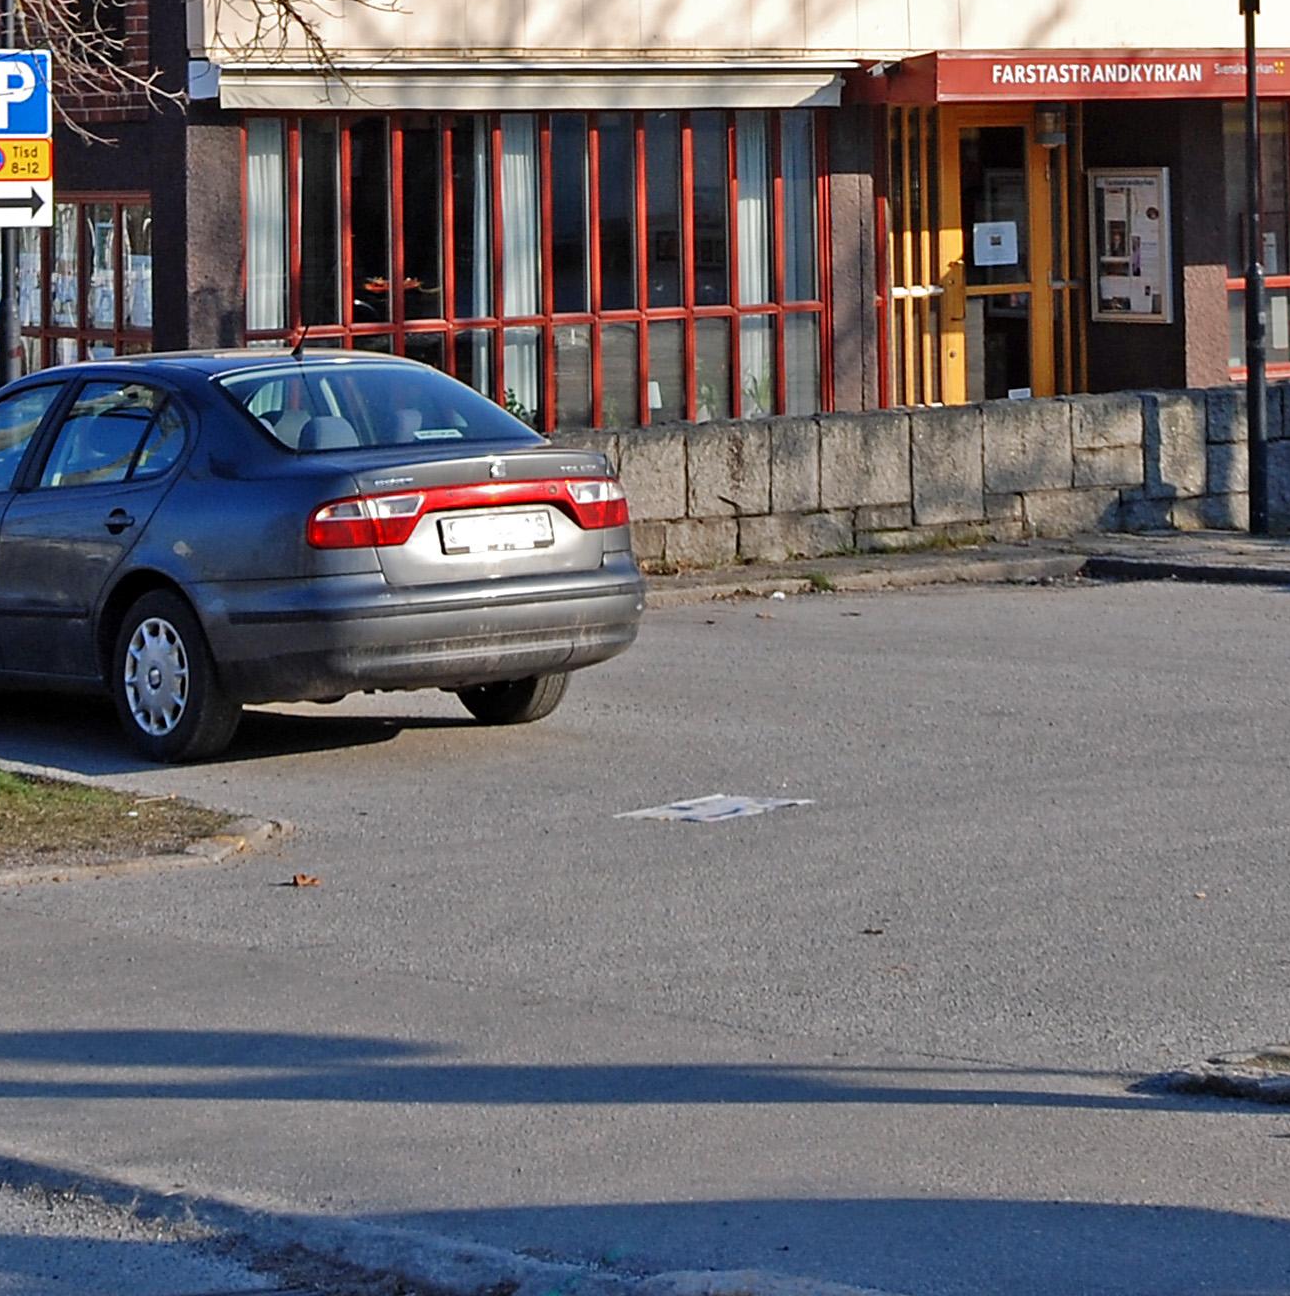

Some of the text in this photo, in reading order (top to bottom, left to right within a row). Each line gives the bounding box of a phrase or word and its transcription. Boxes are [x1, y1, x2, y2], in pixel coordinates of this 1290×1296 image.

[992, 63, 1202, 84] FARSTASTRANDKYRKAN
[12, 146, 38, 159] Tisd
[11, 162, 40, 174] 8-12
